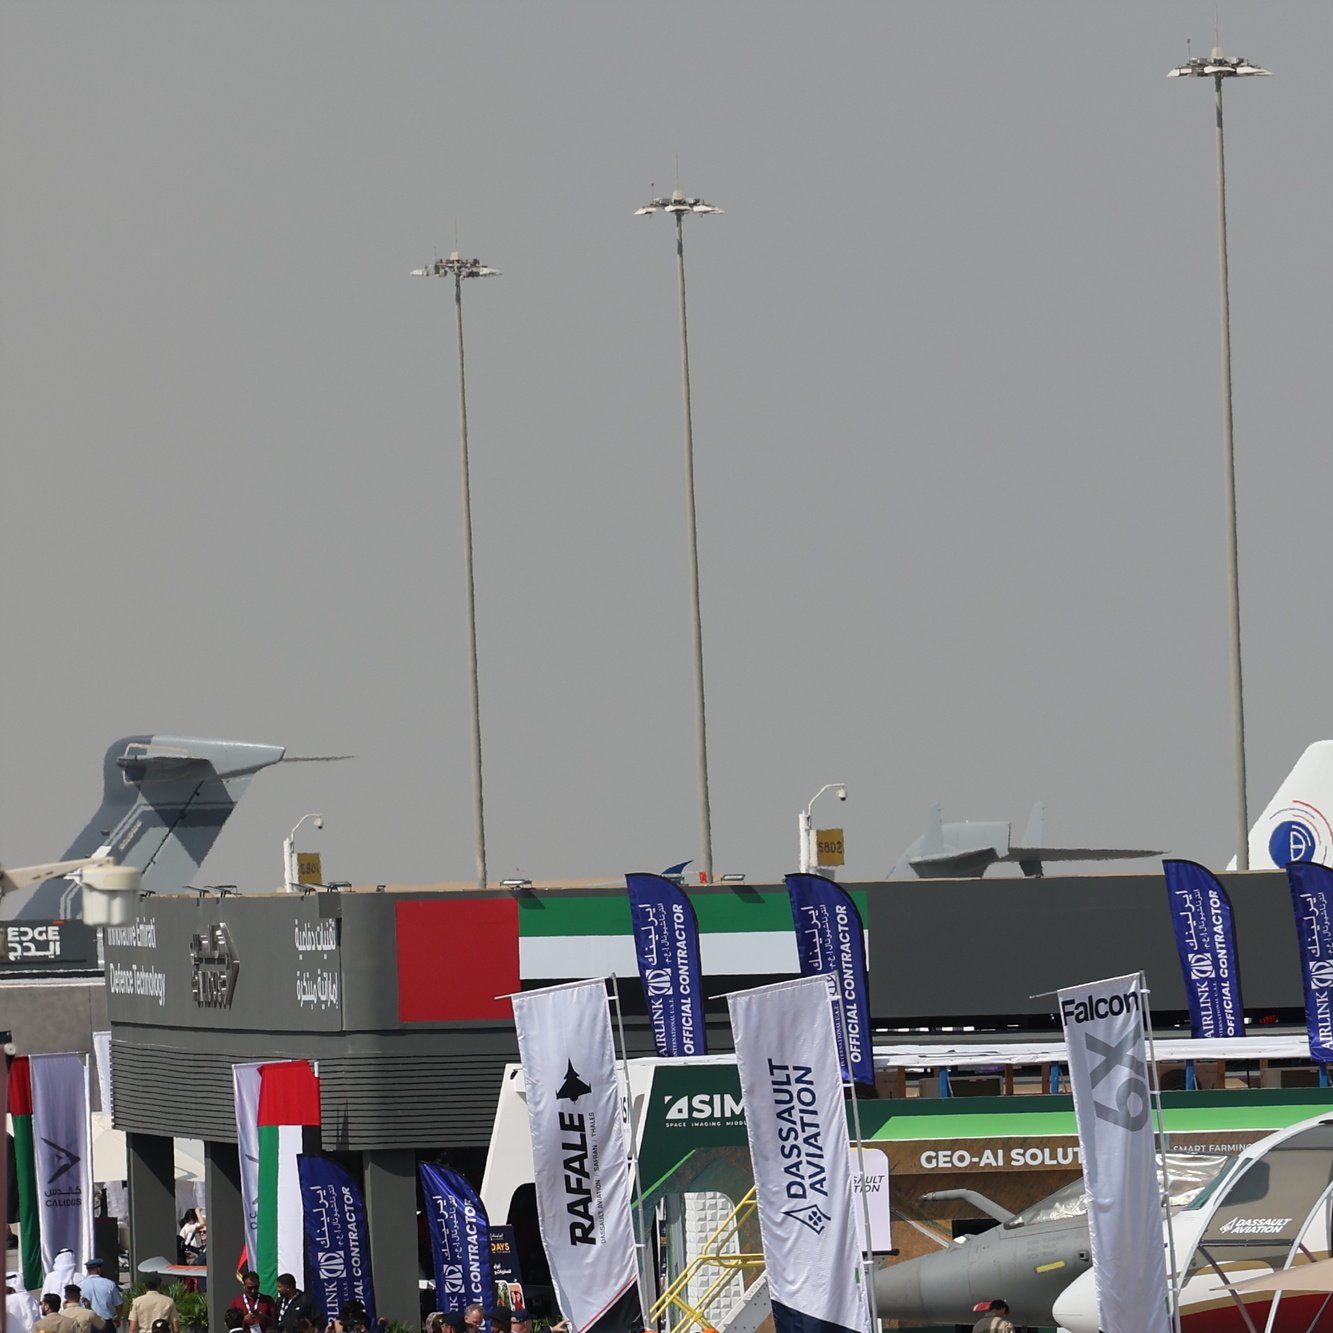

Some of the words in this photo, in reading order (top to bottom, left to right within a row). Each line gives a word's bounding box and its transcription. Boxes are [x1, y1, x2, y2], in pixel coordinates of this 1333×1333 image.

[818, 841, 843, 854] S802
[7, 926, 61, 941] EDGE
[135, 916, 156, 949] Emirati
[672, 903, 691, 994] CONTRACTOR
[835, 905, 857, 1000] CONTRACTOR
[1208, 889, 1229, 978] CONTRACTOR
[110, 961, 133, 994] Defence
[133, 963, 166, 1006] Technology
[1061, 990, 1140, 1027] Falcon
[1220, 980, 1235, 1037] OFFICIAL
[651, 997, 668, 1057] AIRLINK
[680, 996, 695, 1055] OFFICIAL
[843, 1002, 862, 1064] OFFICIAL
[1316, 991, 1333, 1050] AIRLINK
[588, 1111, 598, 1137] THALES
[691, 1093, 746, 1118] SIM
[767, 1058, 807, 1200] DASSAULT
[791, 1064, 829, 1198] AVIATION
[558, 1111, 597, 1247] RAFALE
[919, 1148, 1004, 1169] GEO-AI
[1011, 1146, 1084, 1168] SOLUT
[45, 1198, 82, 1208] CALIDUS
[1231, 1225, 1285, 1234] AVIATION
[1235, 1217, 1293, 1227] DASSAULT
[341, 1186, 363, 1278] CONTRACTOR
